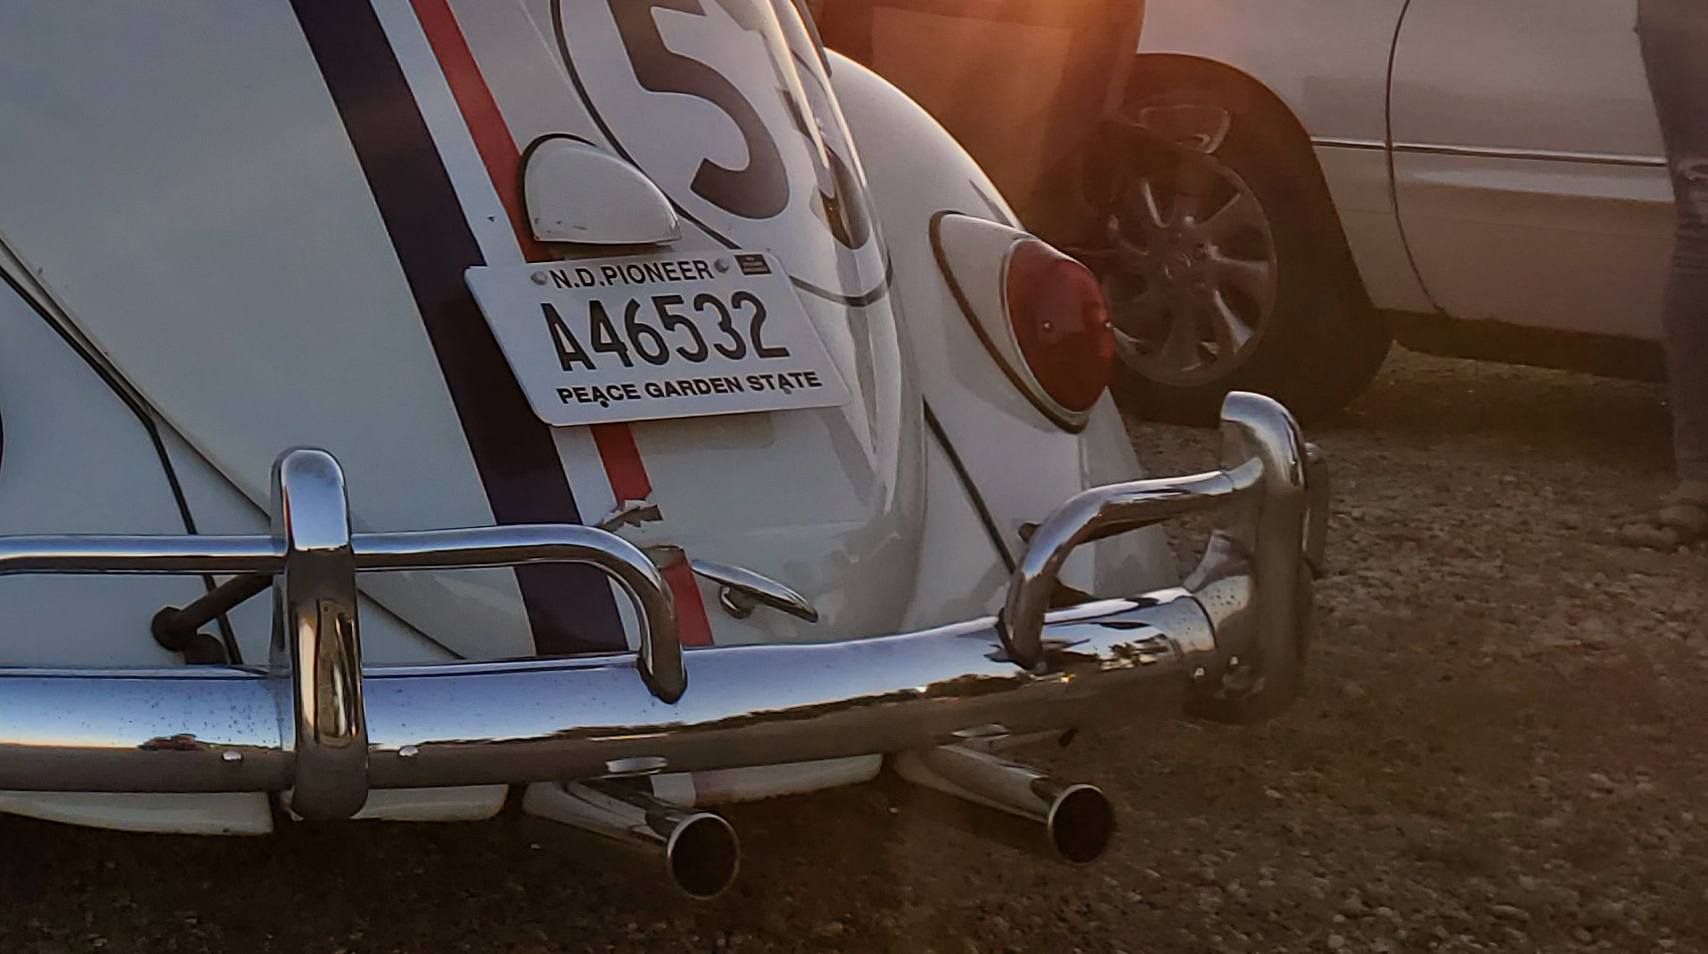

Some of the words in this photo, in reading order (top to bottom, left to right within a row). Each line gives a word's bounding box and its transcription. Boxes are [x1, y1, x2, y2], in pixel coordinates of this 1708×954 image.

[540, 290, 791, 372] A46532
[556, 383, 642, 404] PEACE
[645, 376, 741, 398] GARDEN
[748, 370, 823, 392] STATE
